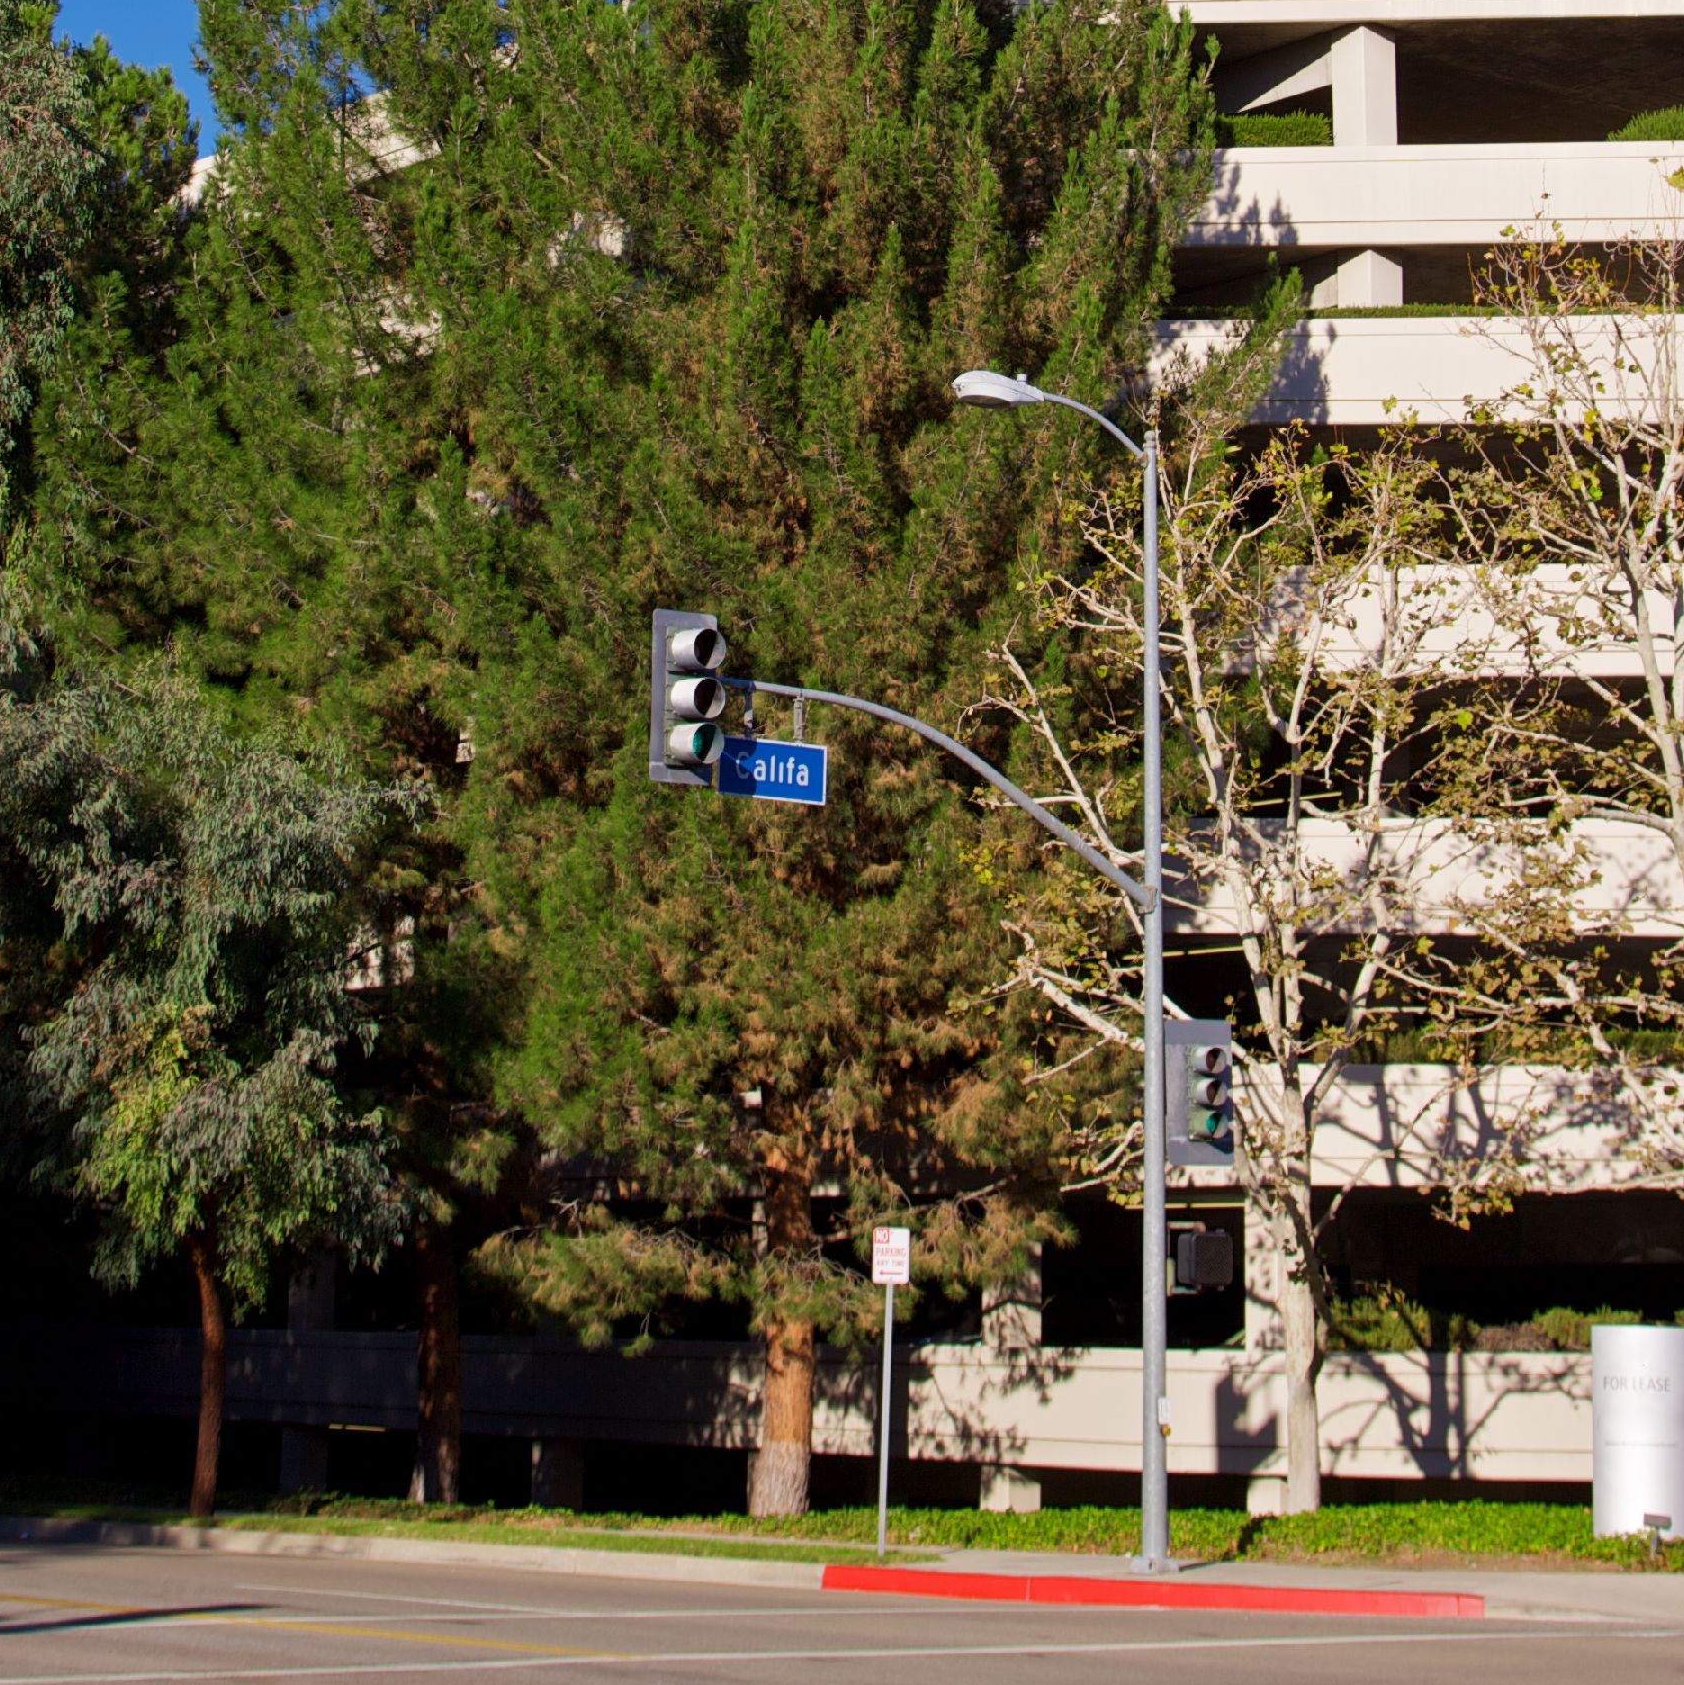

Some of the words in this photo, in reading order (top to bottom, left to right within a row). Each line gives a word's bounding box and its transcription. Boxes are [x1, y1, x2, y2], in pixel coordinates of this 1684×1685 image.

[735, 752, 809, 787] Califa
[876, 1229, 889, 1242] NO
[875, 1247, 906, 1257] PARKING
[1603, 1375, 1627, 1392] FOR
[1632, 1376, 1672, 1393] LEASE
